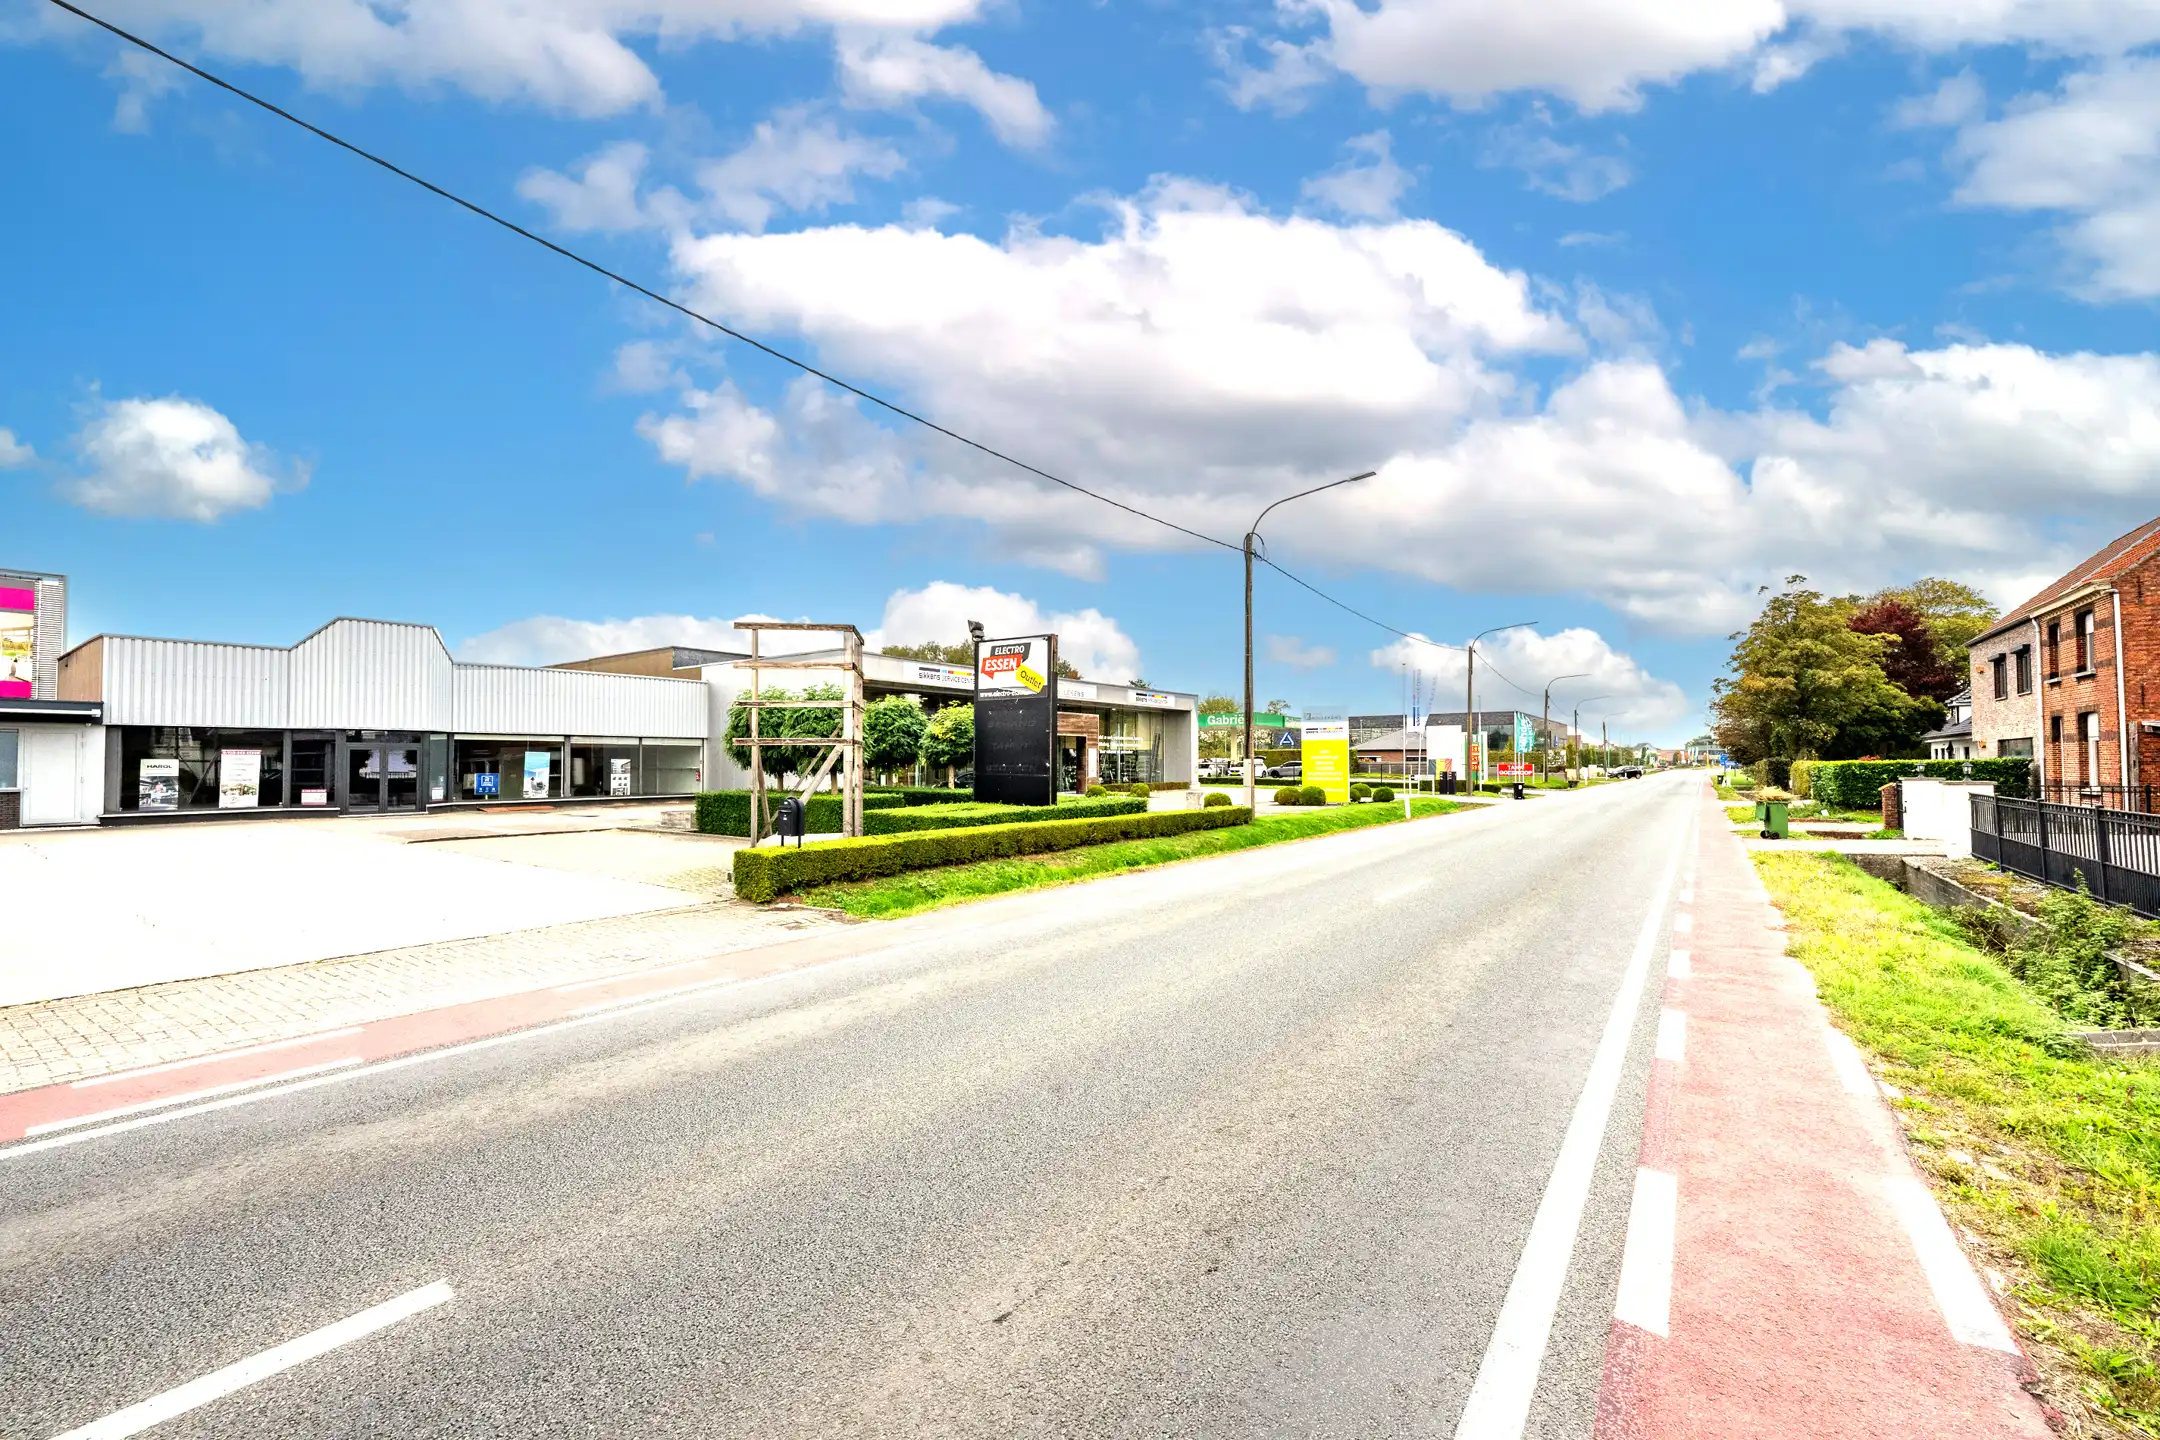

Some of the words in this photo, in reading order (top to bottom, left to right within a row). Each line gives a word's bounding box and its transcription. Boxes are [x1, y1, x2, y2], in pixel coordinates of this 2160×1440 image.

[995, 645, 1025, 656] ELECTRO
[985, 658, 1017, 672] ESSEN
[1020, 670, 1042, 689] Outlet
[1207, 714, 1245, 725] Gabrië
